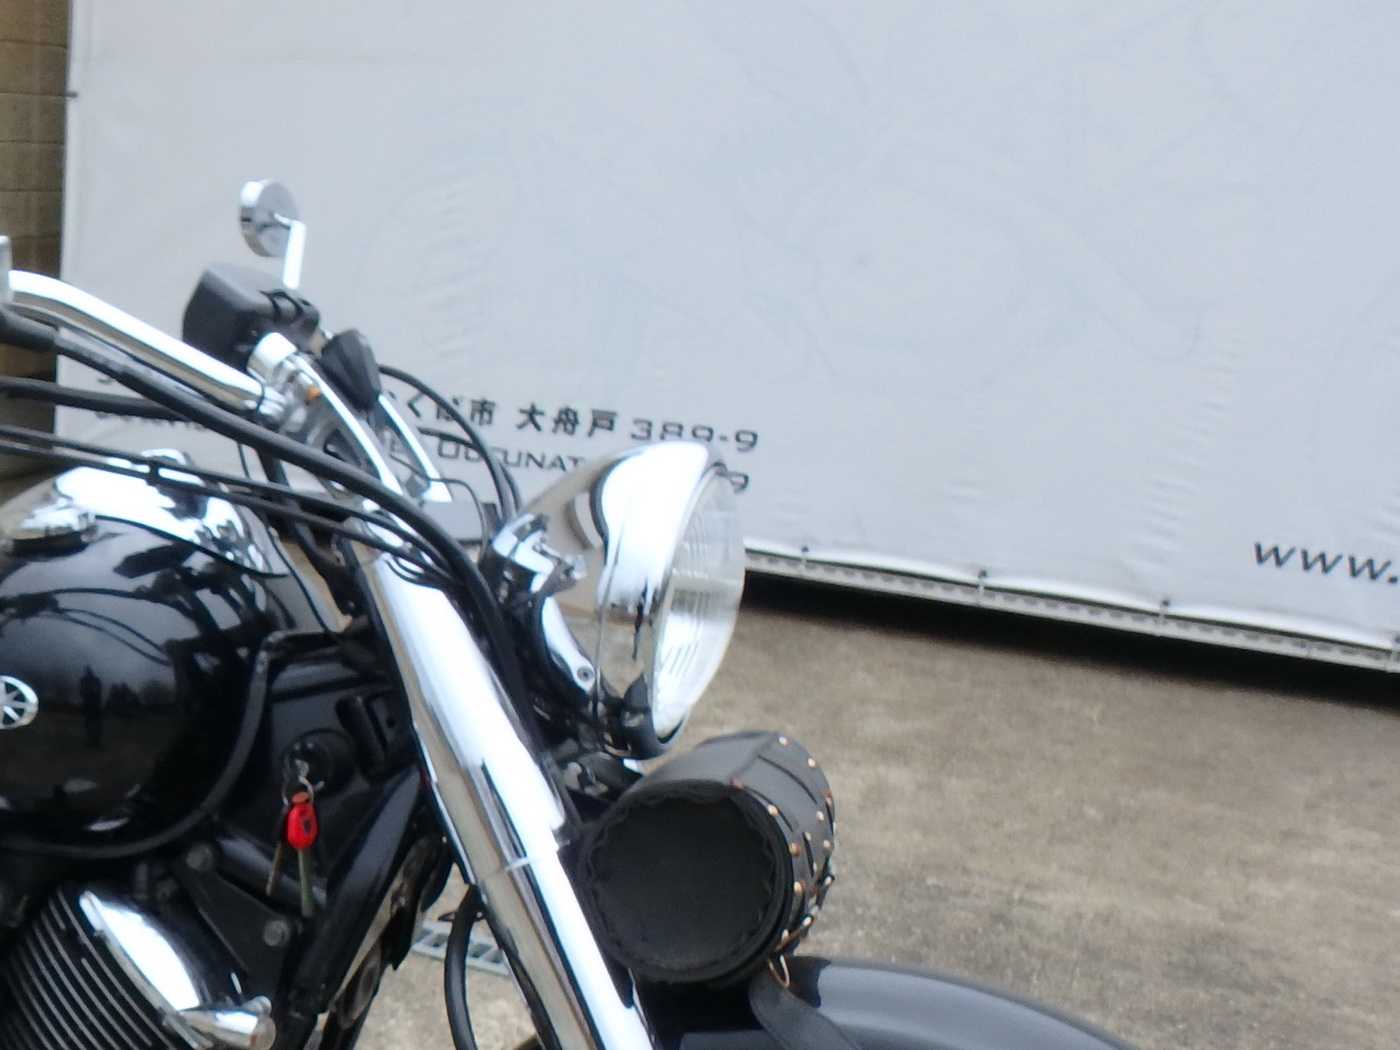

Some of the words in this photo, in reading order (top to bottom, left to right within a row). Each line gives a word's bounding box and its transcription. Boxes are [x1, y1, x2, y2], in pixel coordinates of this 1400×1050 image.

[517, 402, 618, 437] 大舟戸
[631, 417, 759, 453] 389-9
[1254, 541, 1399, 583] www.
